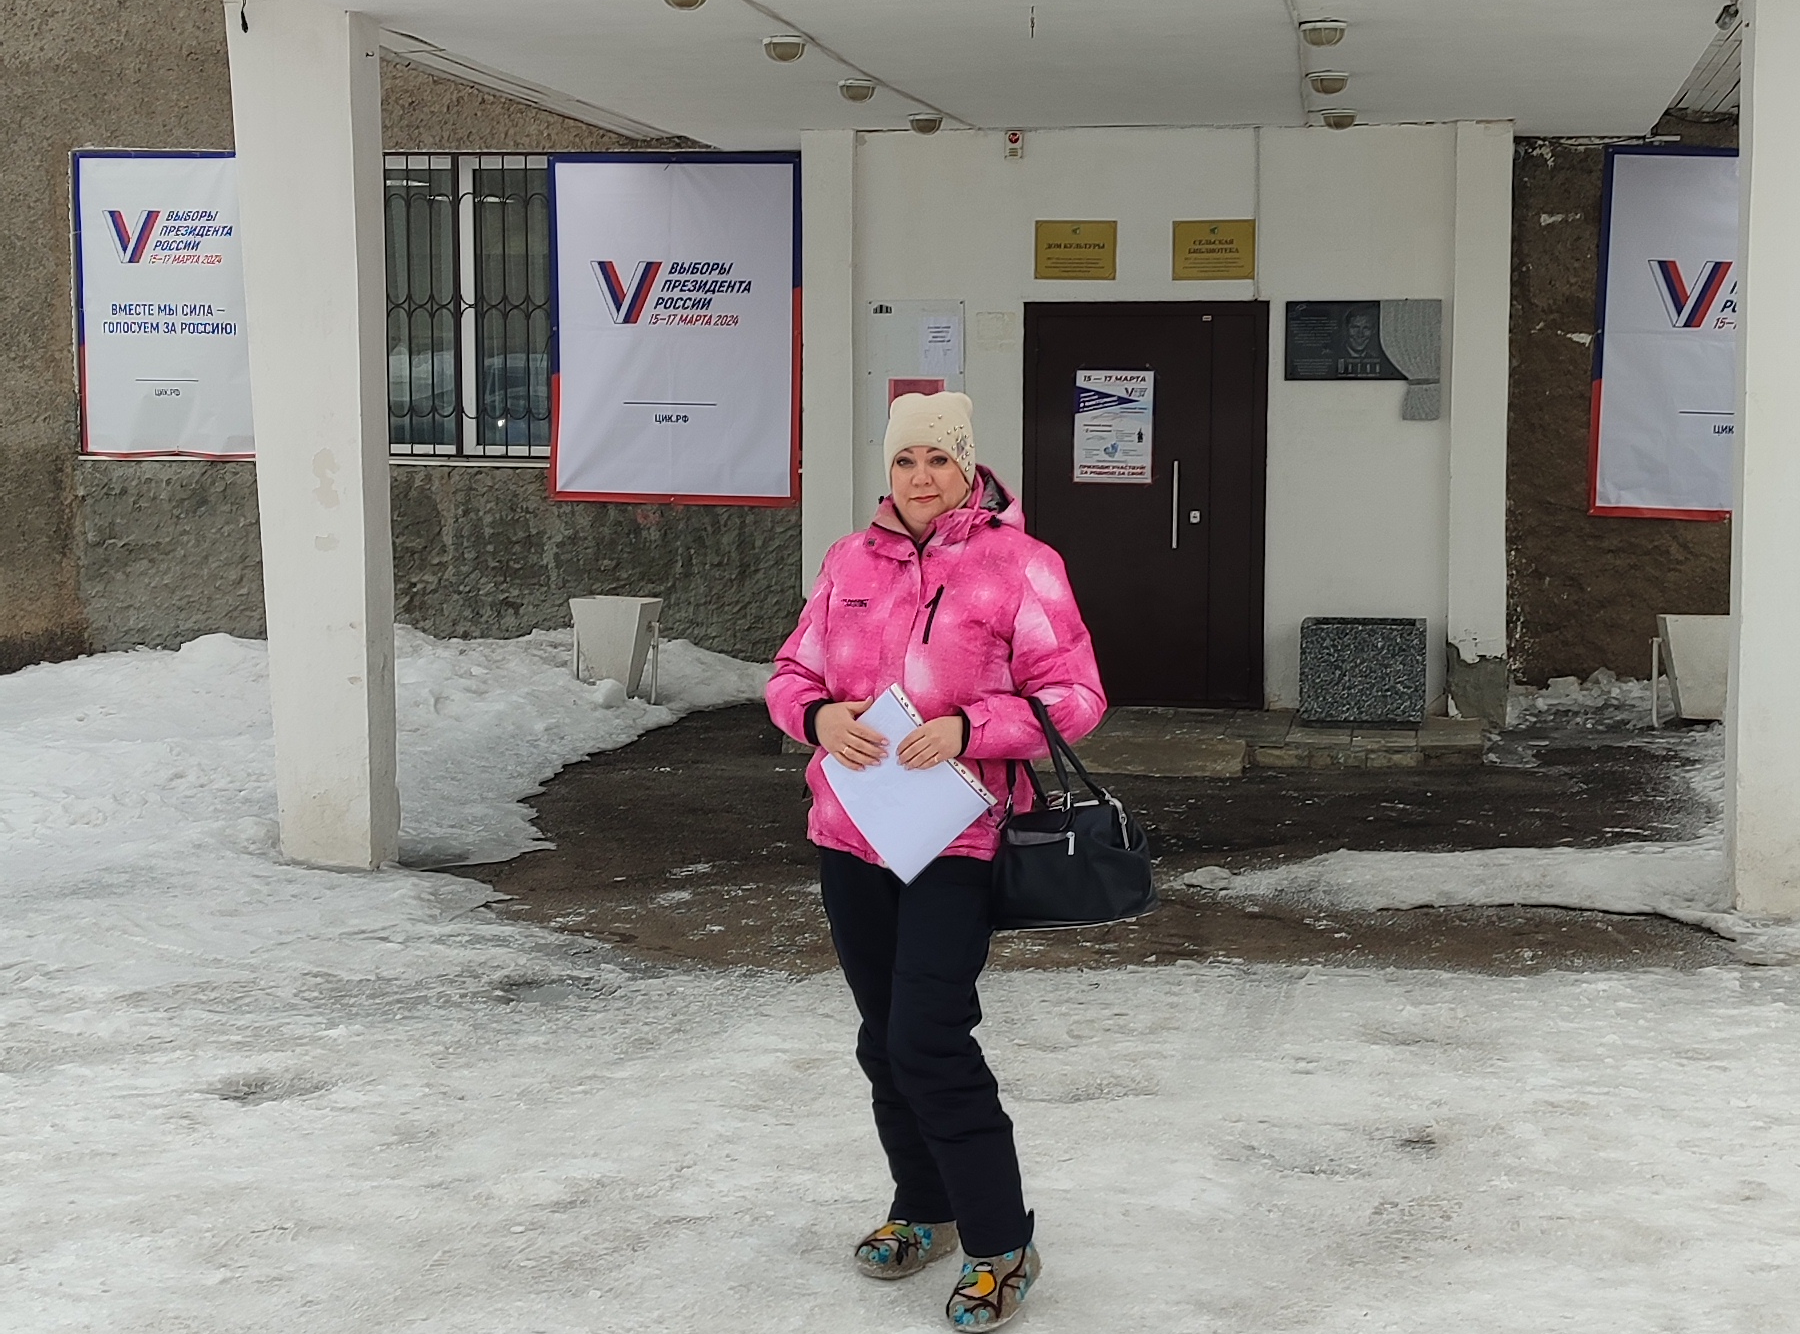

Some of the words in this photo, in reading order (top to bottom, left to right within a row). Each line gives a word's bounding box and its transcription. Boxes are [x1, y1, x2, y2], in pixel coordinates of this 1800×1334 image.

[166, 211, 219, 222] ВЫБОРЫ
[160, 225, 233, 238] ПРЕЗИДЕНТА
[153, 239, 201, 251] РОССИИ
[1063, 242, 1105, 250] КУЛЬТУРЫ
[172, 254, 200, 264] МАРТА
[668, 261, 734, 275] ВЫБОРЫ
[661, 279, 752, 294] ПРЕЗИДЕНТА
[654, 297, 713, 310] РОССИИ
[111, 303, 154, 316] ВМЕСТЕ
[158, 303, 178, 316] МЫ
[181, 304, 214, 317] СИЛА
[677, 314, 713, 325] МАРТА
[713, 314, 739, 326] 2024
[103, 321, 160, 334] ГОЛОСУЕМ
[162, 322, 177, 334] ЗА
[180, 322, 237, 336] РОССИЮ!
[1115, 375, 1147, 383] МАРТА
[654, 413, 689, 424] ЦИК.РФ
[1713, 424, 1735, 437] ЦИК
